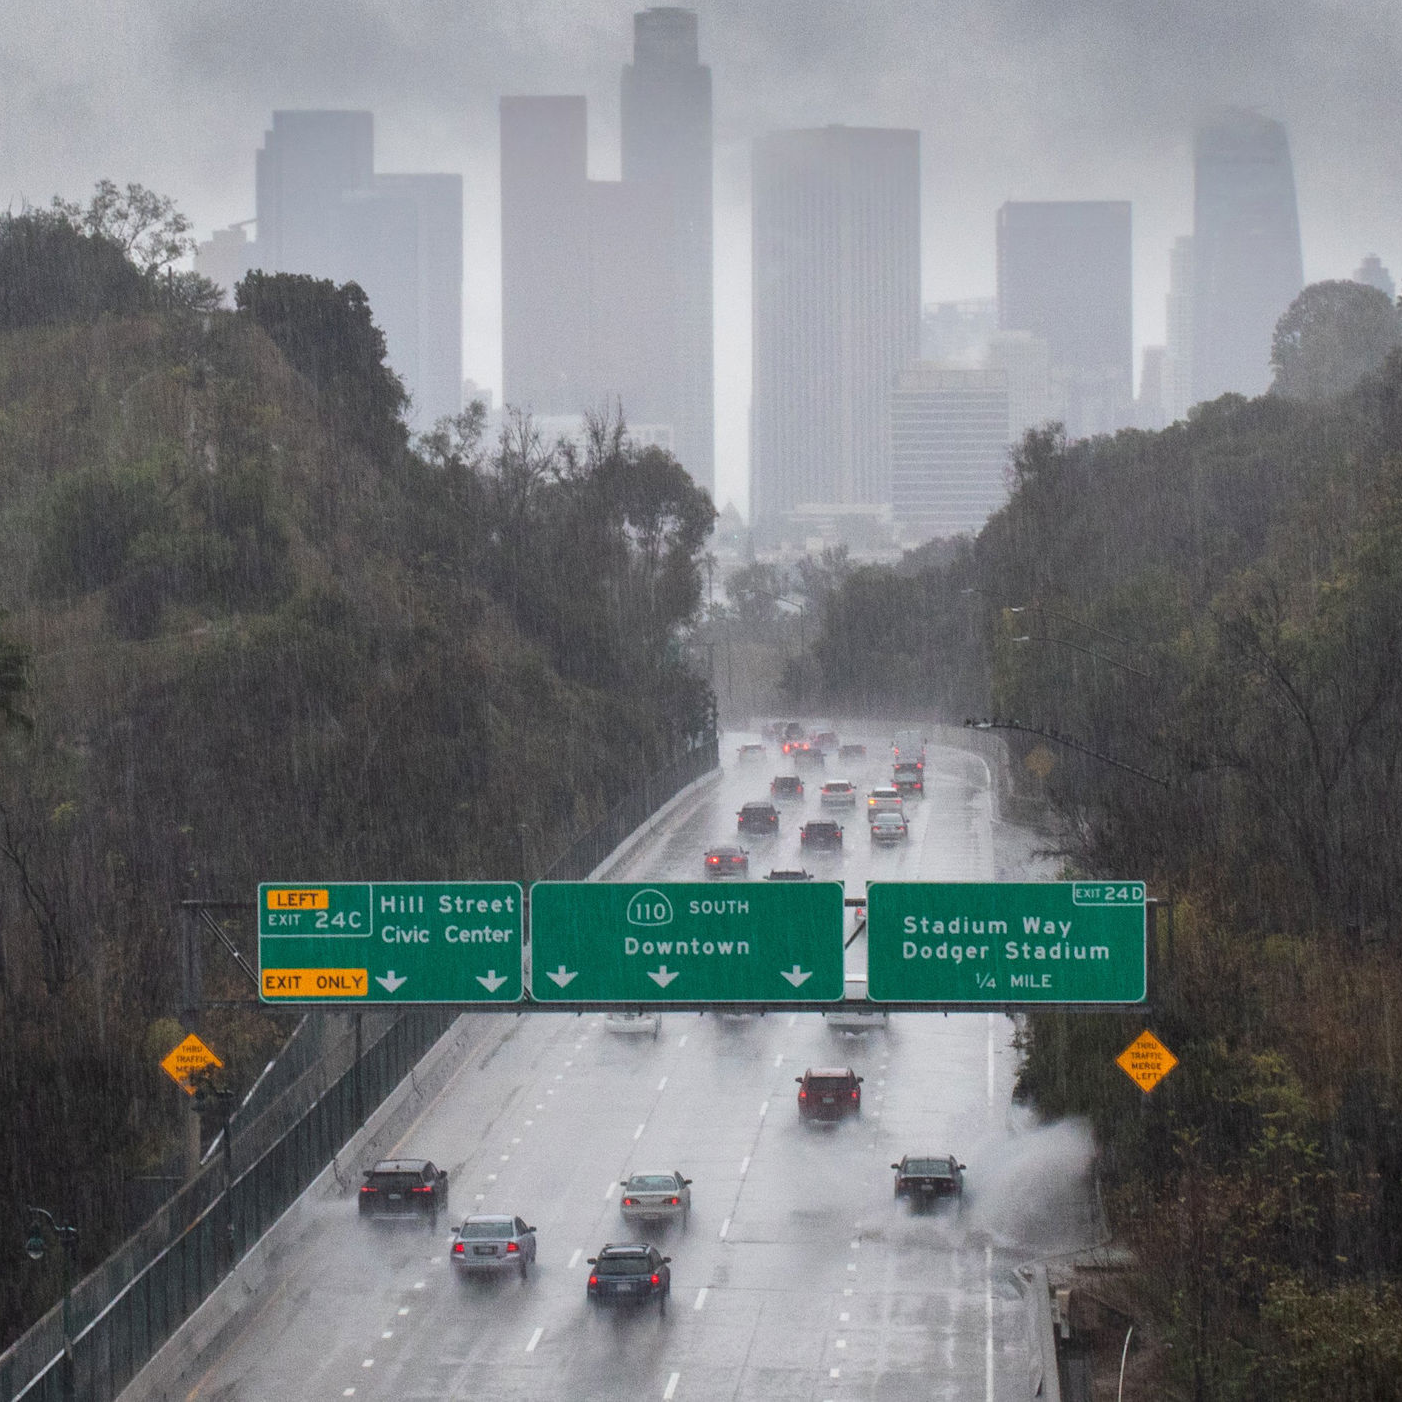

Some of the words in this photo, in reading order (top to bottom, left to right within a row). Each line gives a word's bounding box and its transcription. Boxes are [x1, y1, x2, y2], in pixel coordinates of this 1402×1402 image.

[277, 893, 319, 907] LEFT
[1075, 888, 1101, 899] EXIT
[1104, 886, 1143, 900] 24D
[380, 895, 424, 913] Hill
[438, 895, 514, 913] Street
[635, 902, 666, 921] 110
[689, 900, 750, 914] SOUTH
[268, 913, 301, 927] EXIT
[315, 911, 362, 928] 24C
[381, 925, 430, 943] Civic
[444, 925, 513, 943] Center
[903, 916, 1008, 934] Stadium
[1022, 916, 1072, 939] Way
[624, 936, 750, 955] Downtown
[902, 941, 990, 965] Dodger
[1005, 941, 1110, 960] Stadium
[265, 975, 302, 989] EXIT
[316, 975, 364, 989] ONLY
[1010, 974, 1053, 988] MILE
[182, 1045, 203, 1053] THRU
[1131, 1052, 1162, 1060] TRAFFIC
[176, 1055, 207, 1063] TRAFFIC
[1131, 1062, 1161, 1070] MERGE
[1136, 1072, 1157, 1080] LEFT
